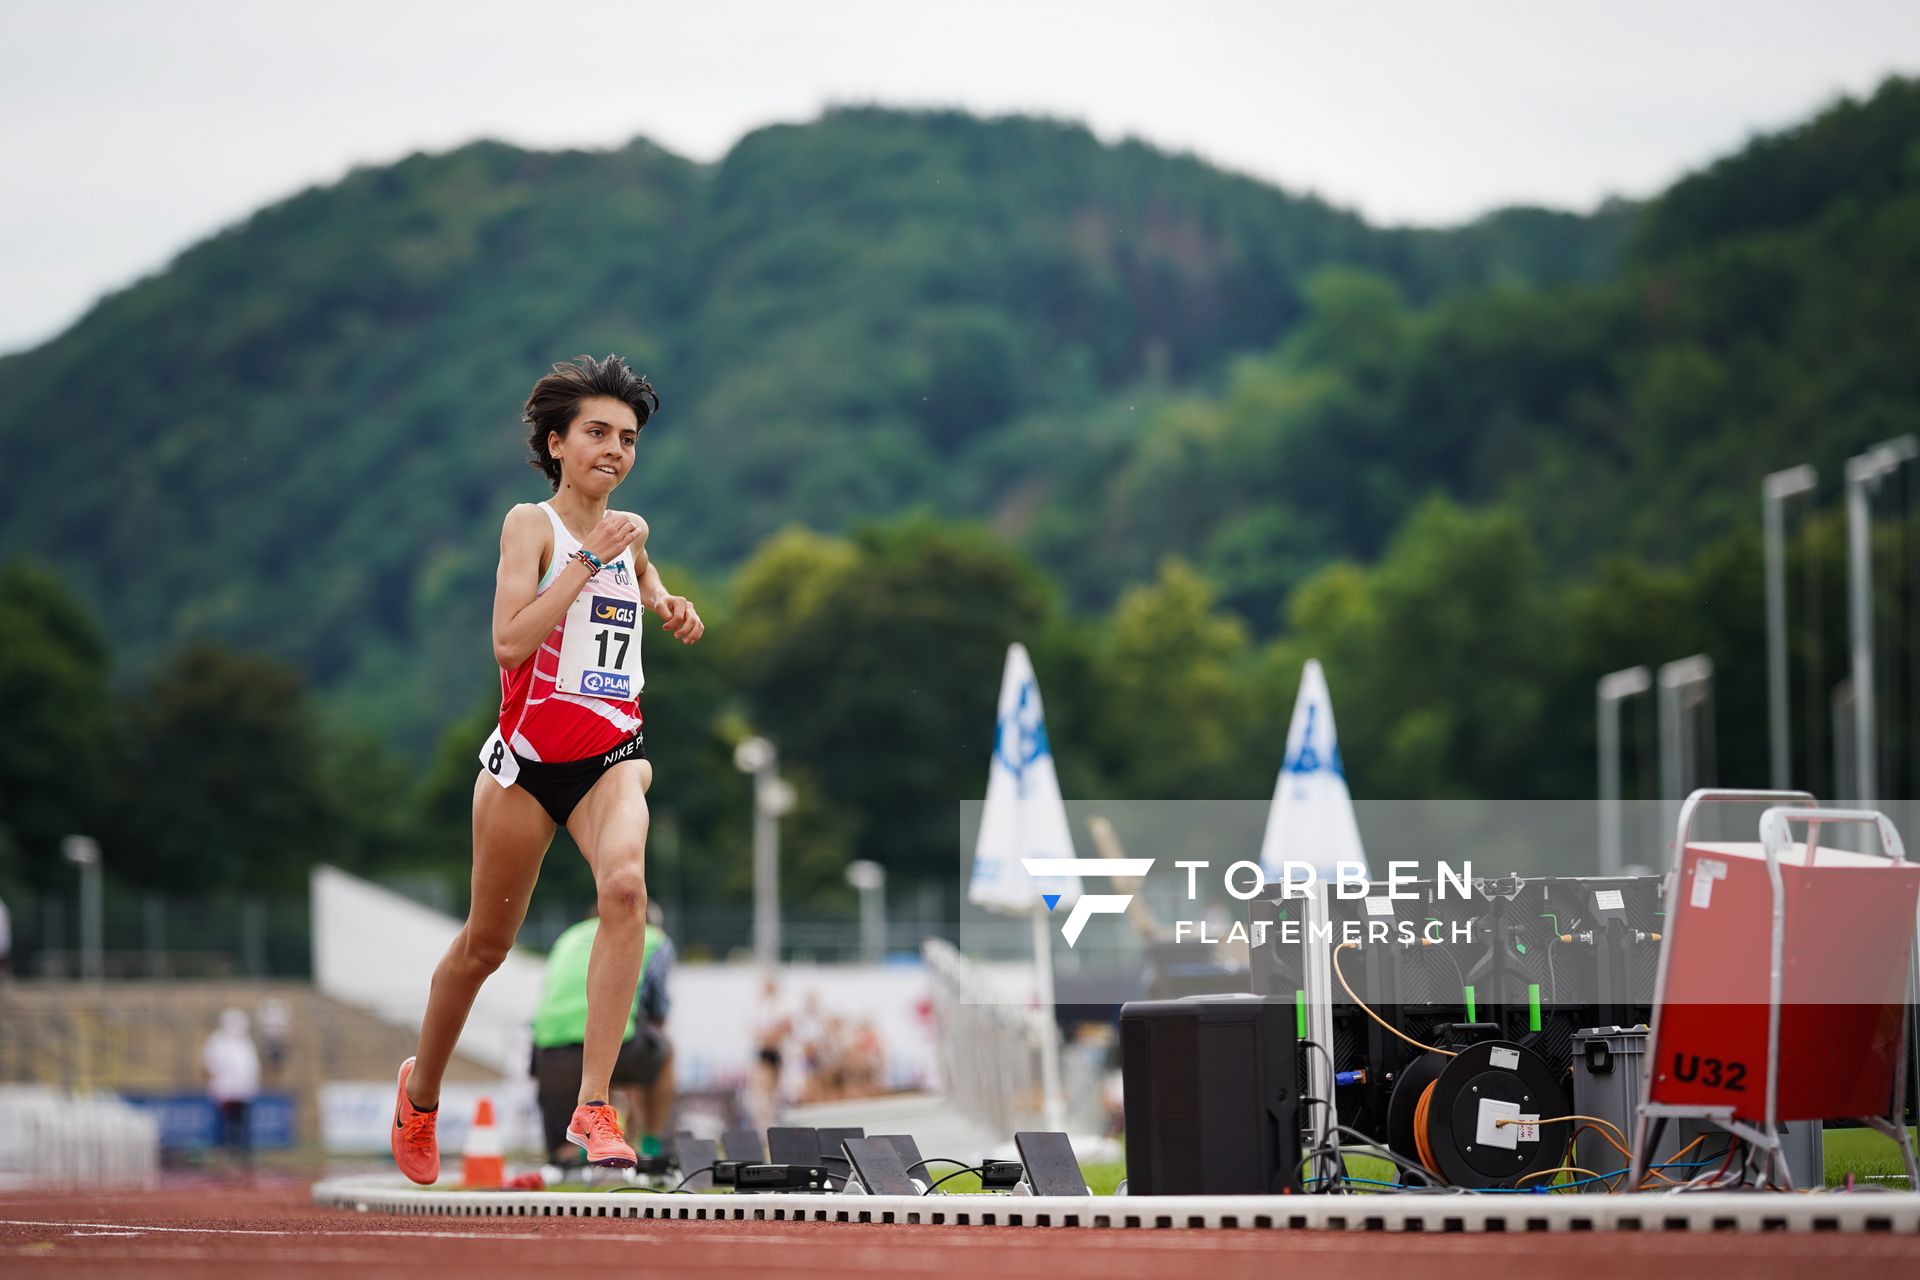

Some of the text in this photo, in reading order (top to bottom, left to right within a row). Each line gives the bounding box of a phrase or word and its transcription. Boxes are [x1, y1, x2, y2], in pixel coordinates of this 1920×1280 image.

[614, 573, 633, 586] QU
[615, 607, 634, 623] GLS
[595, 629, 630, 670] 17
[604, 677, 629, 691] PLAN
[488, 739, 505, 776] 8
[603, 741, 634, 767] NIKE
[1673, 1052, 1747, 1093] U32
